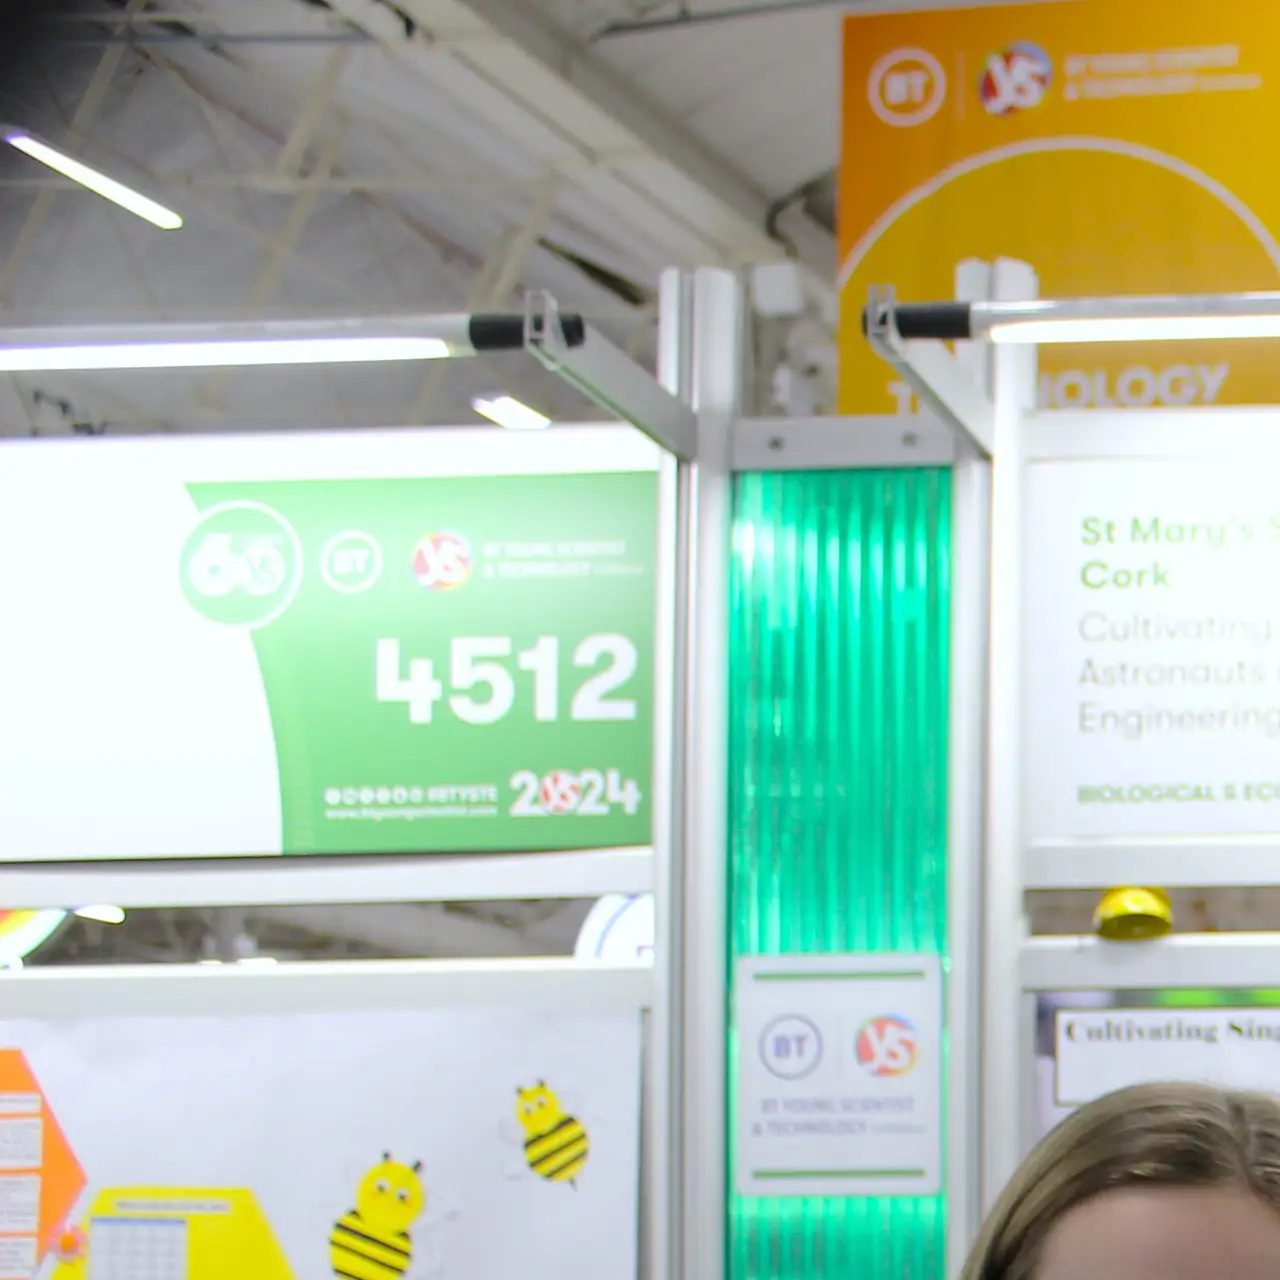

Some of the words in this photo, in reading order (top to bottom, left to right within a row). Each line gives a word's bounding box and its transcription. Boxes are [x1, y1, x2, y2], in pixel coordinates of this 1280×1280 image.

[885, 71, 928, 105] BT
[1079, 515, 1117, 546] St
[1130, 513, 1257, 551] Mary's
[333, 549, 369, 575] BT
[1079, 558, 1172, 591] Cork
[1078, 609, 1273, 649] Cultivating
[375, 632, 638, 725] 4512
[1078, 656, 1266, 686] Astronauts
[1077, 783, 1217, 803] BIOLOGICAL
[1065, 1017, 1219, 1044] Cultivating
[773, 1035, 808, 1060] BT
